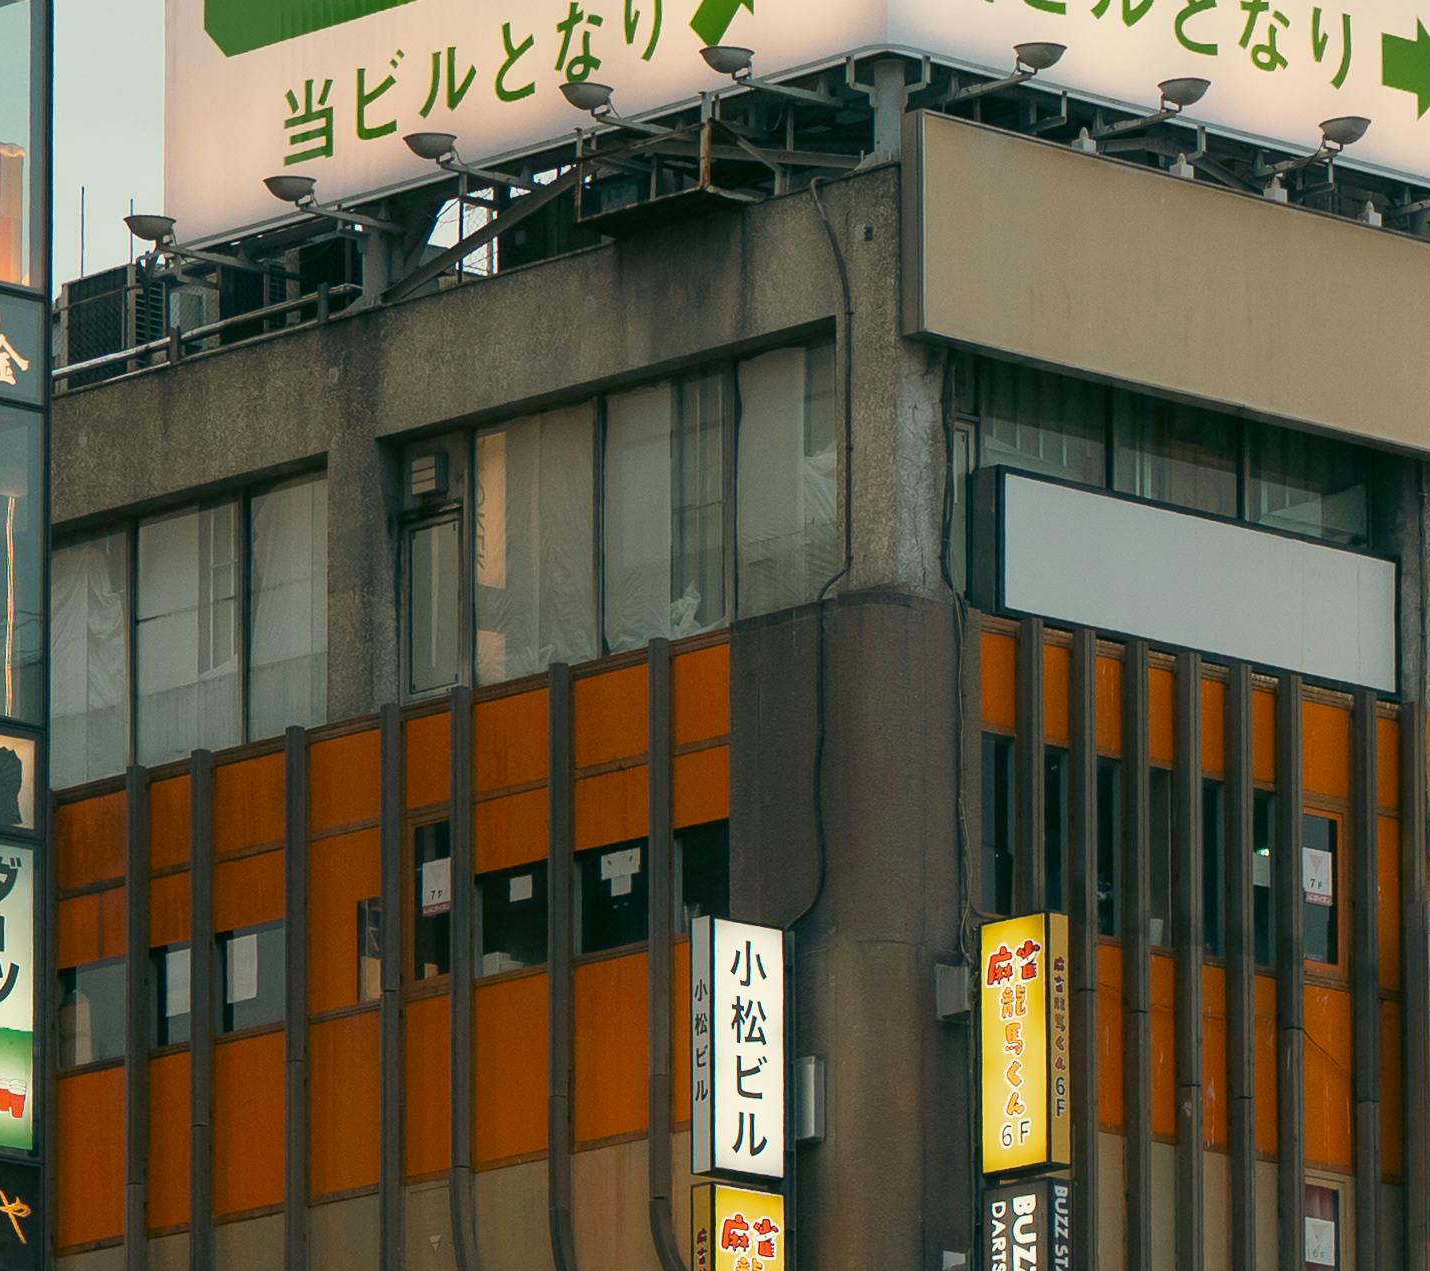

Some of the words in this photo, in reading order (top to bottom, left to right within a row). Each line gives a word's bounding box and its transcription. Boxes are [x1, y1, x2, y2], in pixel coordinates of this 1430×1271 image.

[693, 979, 709, 1102] 小松ビル
[730, 940, 768, 1157] 小松ビル
[1001, 1121, 1032, 1148] 6F
[1054, 1185, 1069, 1243] BUZZ
